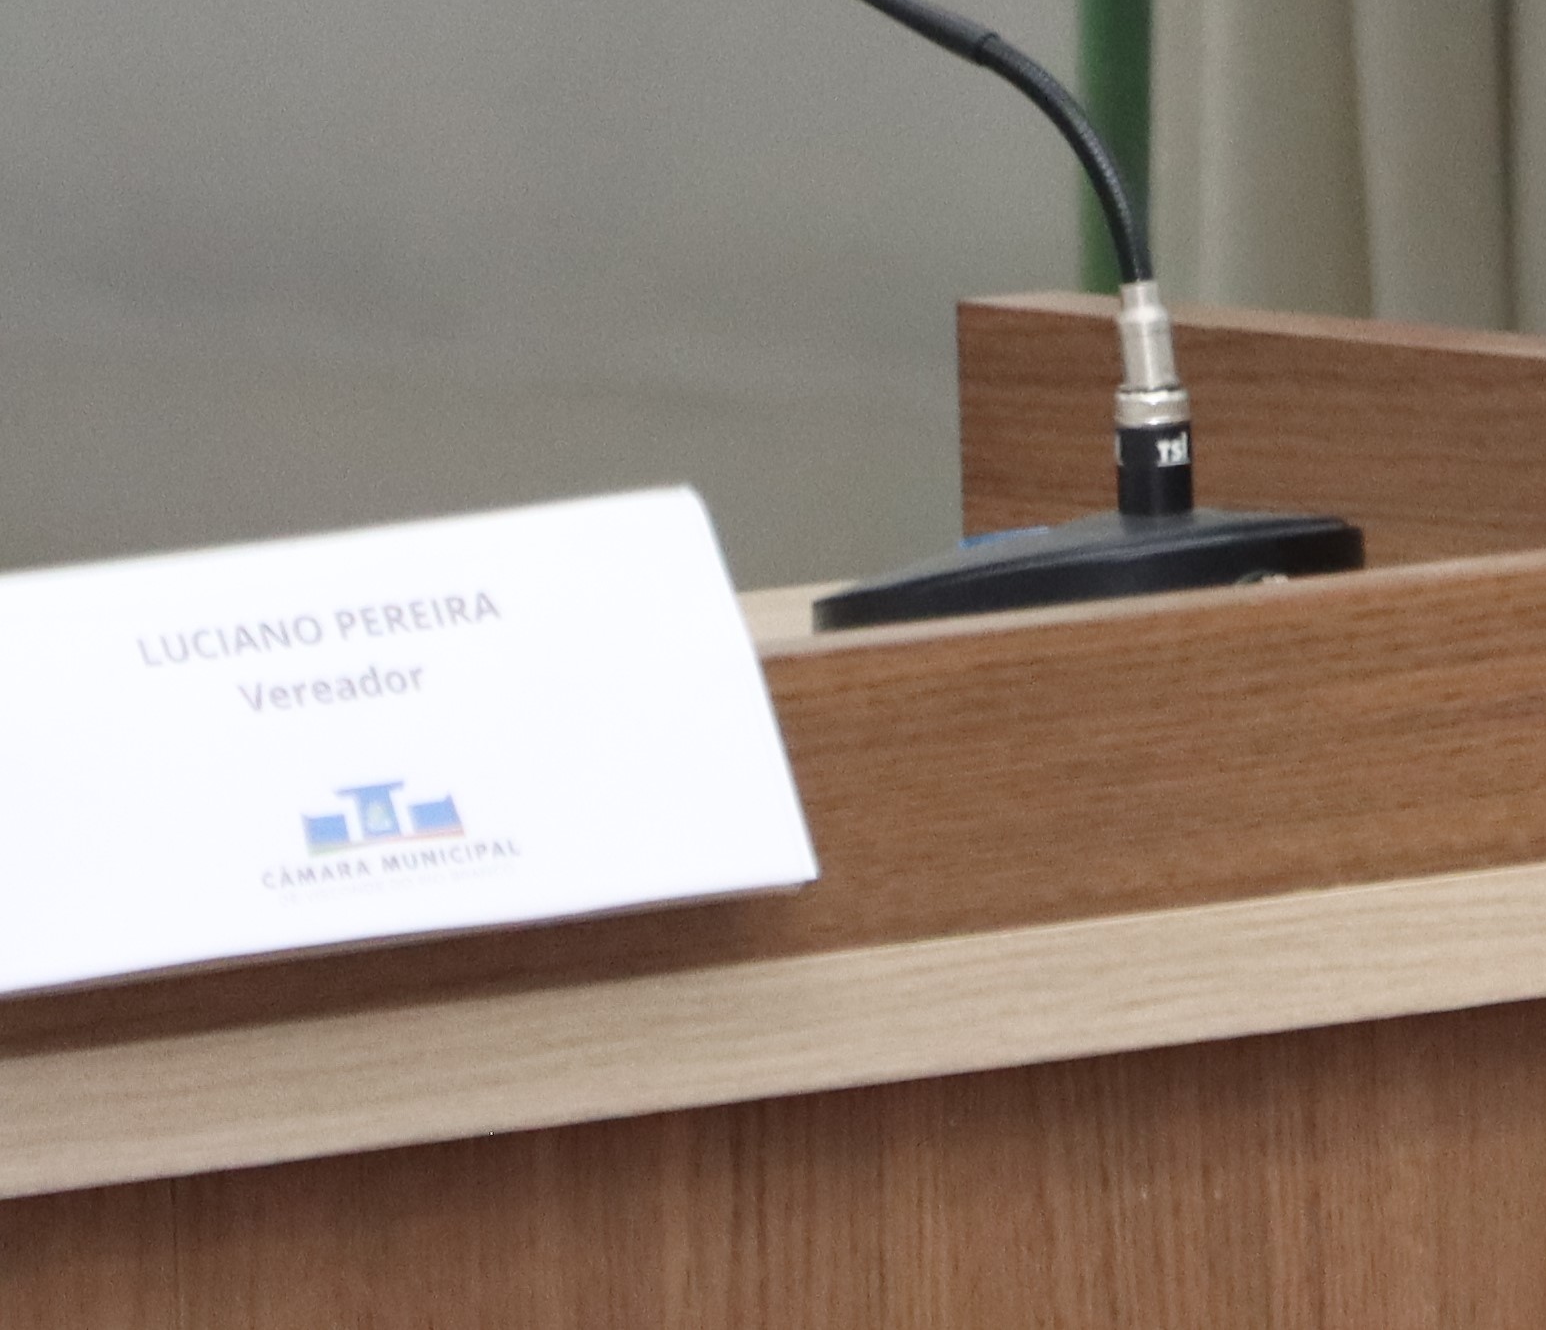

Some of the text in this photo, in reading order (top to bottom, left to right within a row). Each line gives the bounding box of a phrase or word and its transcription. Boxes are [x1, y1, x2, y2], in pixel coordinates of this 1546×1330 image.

[137, 591, 501, 667] LUCIANO PEREIRA
[237, 666, 424, 712] Vereador
[381, 839, 521, 873] MUNICIPAL
